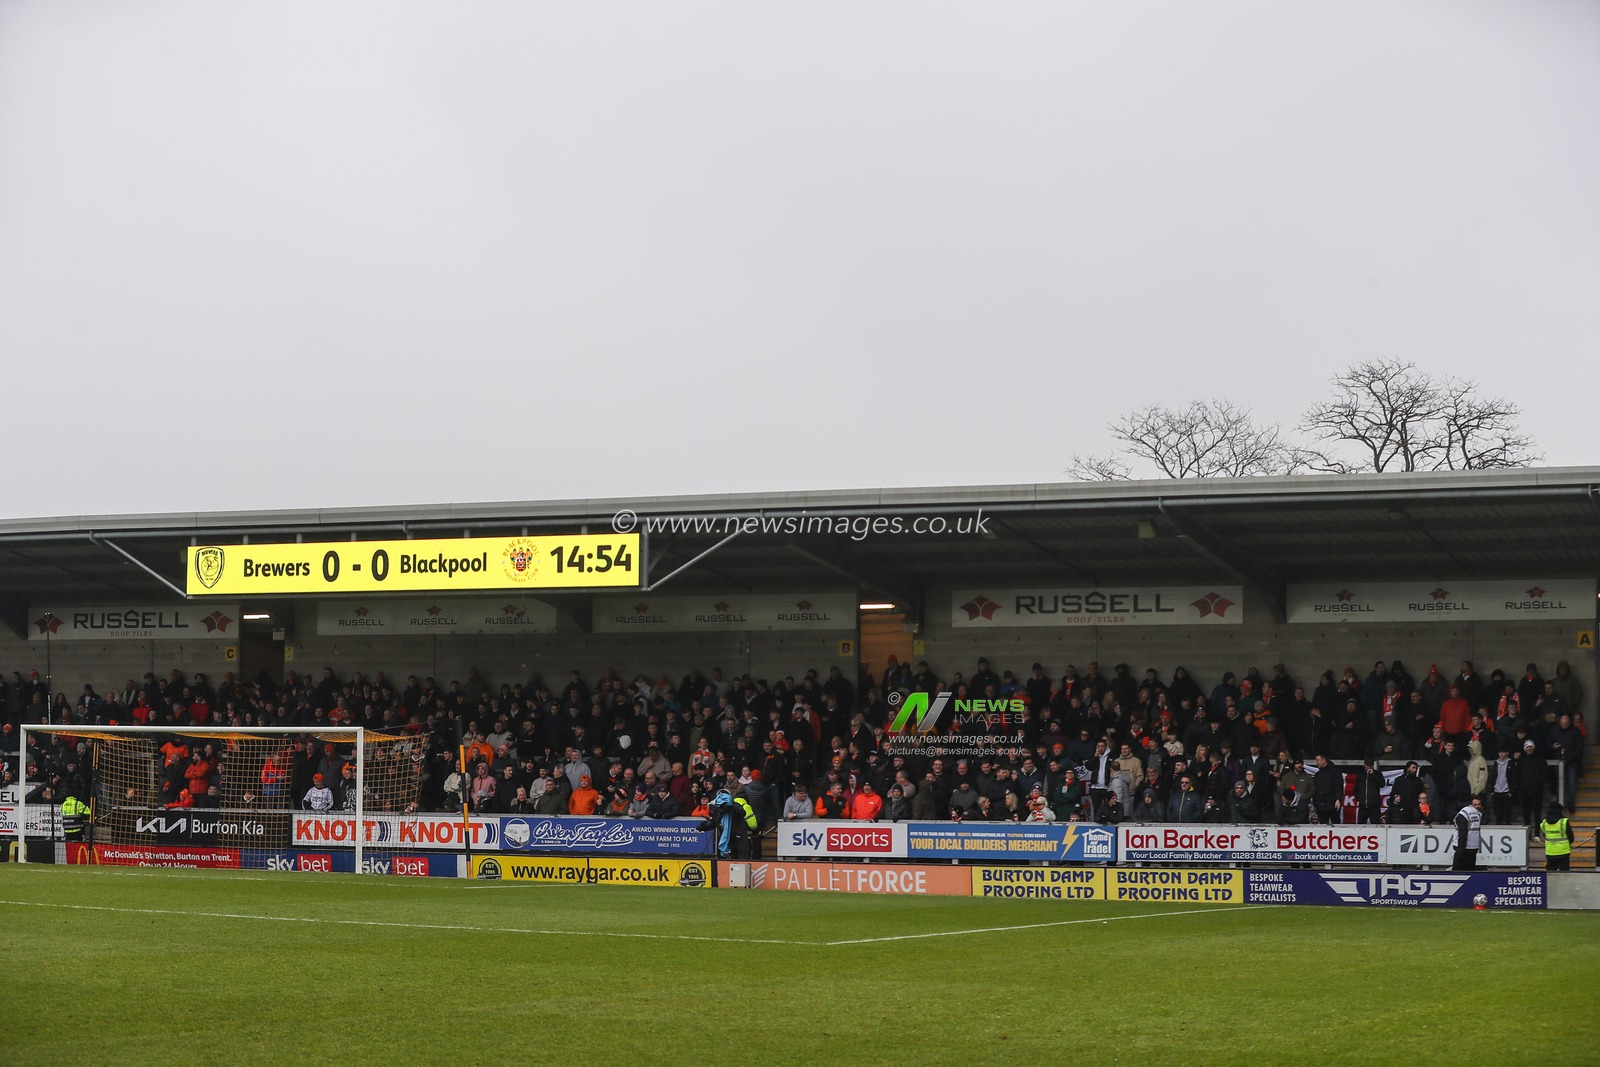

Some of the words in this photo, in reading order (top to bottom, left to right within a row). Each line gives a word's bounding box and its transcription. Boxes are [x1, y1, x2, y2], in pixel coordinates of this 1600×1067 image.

[243, 558, 310, 577] Brewers
[322, 550, 340, 582] 0
[371, 548, 389, 581] 0
[400, 551, 487, 578] Blackpool
[550, 544, 631, 573] 14:54
[1015, 590, 1175, 615] RUSSELL
[1314, 602, 1374, 613] RUSSELL
[1408, 601, 1470, 612] RUSSELL
[1505, 600, 1566, 610] RUSSELL
[73, 609, 189, 630] RUSSELL
[338, 617, 384, 627] RUSSELL
[410, 616, 457, 626] RUSSELL
[485, 616, 533, 625] RUSSELL
[615, 614, 667, 624] RUSSELL
[695, 613, 747, 623] RUSSELL
[777, 612, 830, 622] RUSSELL
[1066, 616, 1093, 624] ROOF
[1097, 615, 1125, 623] TILES
[1579, 633, 1591, 646] A
[226, 648, 235, 659] C
[192, 818, 238, 835] Burton
[242, 820, 264, 835] Kia
[296, 819, 376, 842] KNOTT
[400, 821, 483, 844] KNOTT
[1088, 828, 1108, 841] home
[792, 828, 824, 850] sky
[829, 831, 889, 850] sports
[1125, 829, 1158, 849] Ian
[1163, 830, 1240, 849] Barker
[1277, 829, 1379, 850] Butchers
[911, 838, 934, 849] YOUR
[935, 838, 962, 850] LOCAL
[964, 839, 1007, 851] BUILDERS
[1008, 840, 1058, 852] MERCHANT
[104, 850, 144, 860] McDonald's
[176, 852, 200, 861] Burton
[201, 854, 211, 862] on
[211, 853, 232, 862] Trent.
[1169, 852, 1193, 860] Family
[1294, 852, 1372, 861] barkerbutchers.co.uk
[267, 854, 297, 872] sky
[300, 856, 328, 872] bet
[361, 857, 390, 875] sky
[396, 858, 425, 876] bet
[511, 864, 669, 884] www.raygar.co.uk
[982, 869, 1045, 883] BURTON
[1050, 870, 1095, 884] DAMP
[1117, 871, 1181, 885] BURTON
[1187, 872, 1233, 885] DAMP
[1250, 873, 1283, 882] BESPOKE
[1508, 876, 1542, 885] BESPOKE
[983, 885, 1062, 899] PROOFING
[1067, 887, 1095, 899] LTD
[1250, 883, 1293, 892] TEAMWEAR
[1498, 886, 1542, 895] TEAMWEAR
[1118, 887, 1199, 901] PROOFING
[1204, 888, 1233, 901] LTD
[1250, 892, 1296, 902] SPECIALISTS
[1371, 898, 1418, 906] SPORTSWEAR
[1494, 896, 1542, 906] SPECIALISTS
